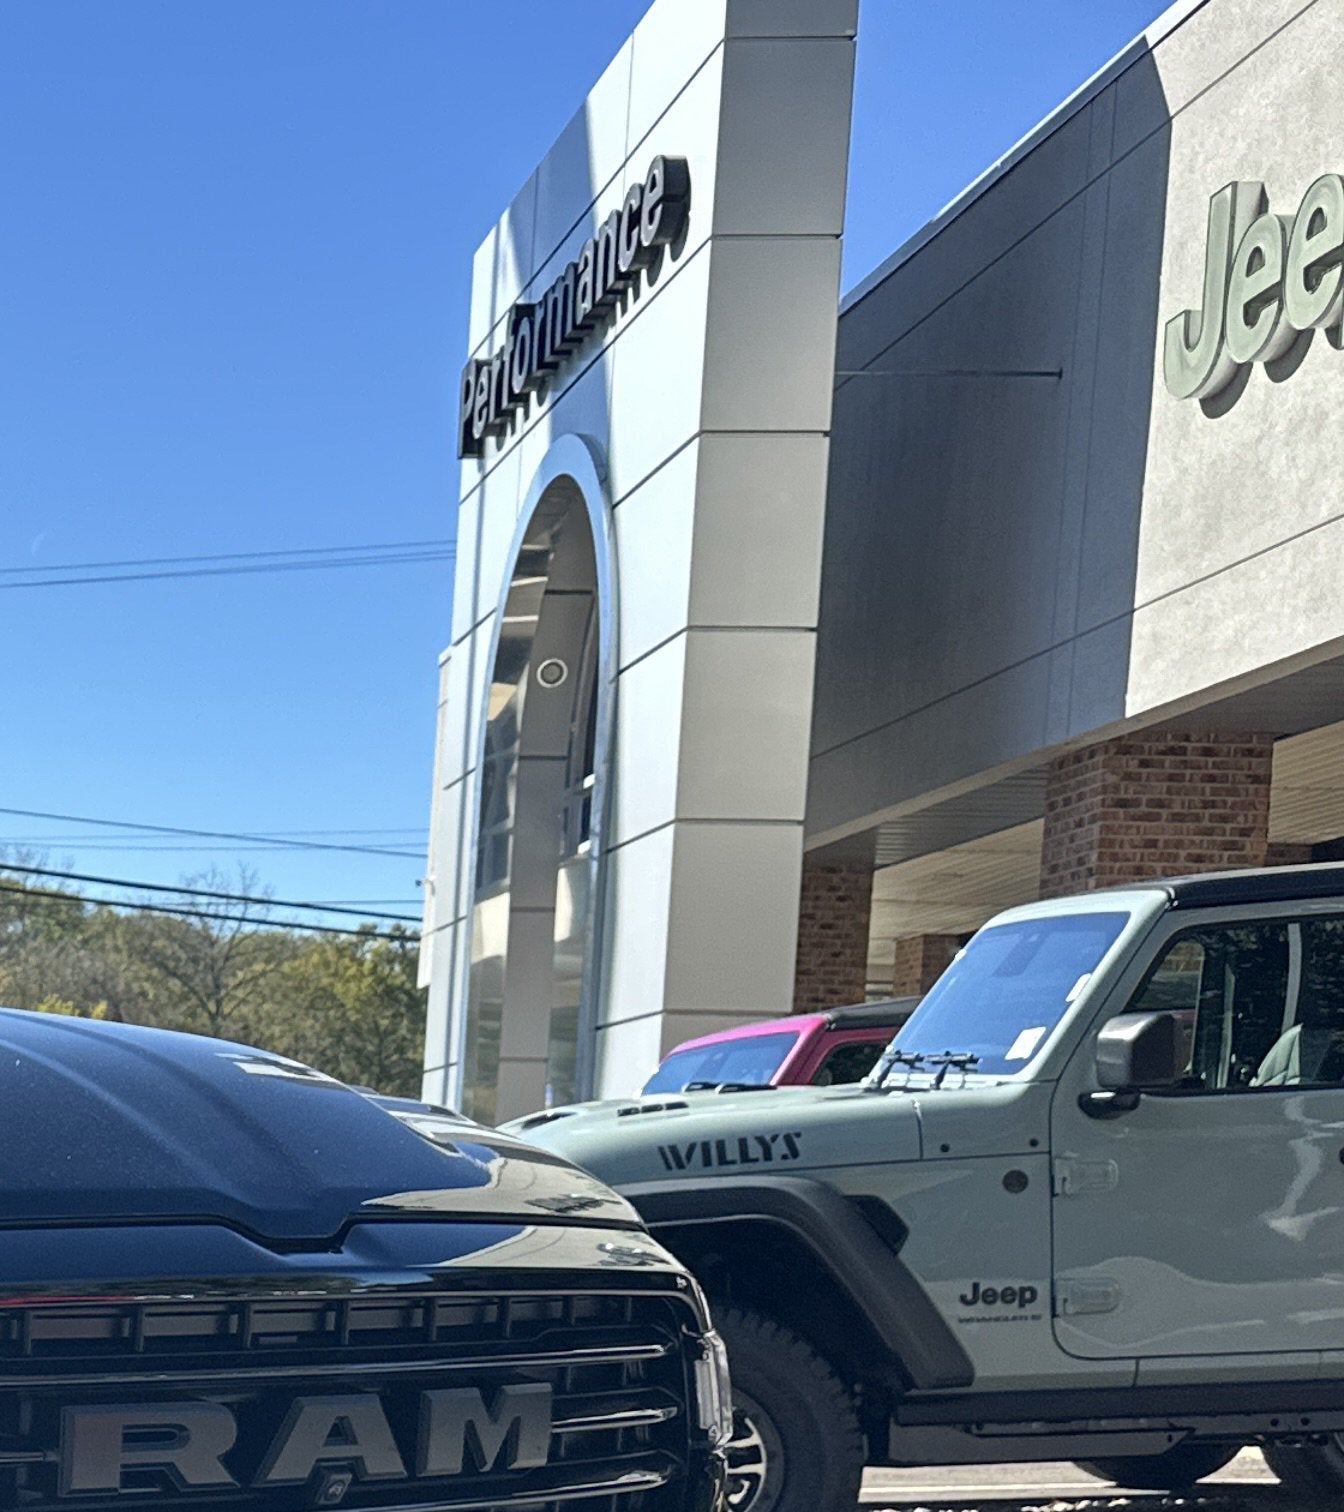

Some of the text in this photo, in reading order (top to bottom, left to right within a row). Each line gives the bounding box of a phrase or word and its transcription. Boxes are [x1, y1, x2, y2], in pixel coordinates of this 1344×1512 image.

[459, 155, 691, 458] Performance
[1164, 174, 1344, 400] Jee
[658, 1132, 802, 1171] WILLYS
[960, 1282, 1038, 1308] Jeep
[58, 1382, 553, 1497] RAM
